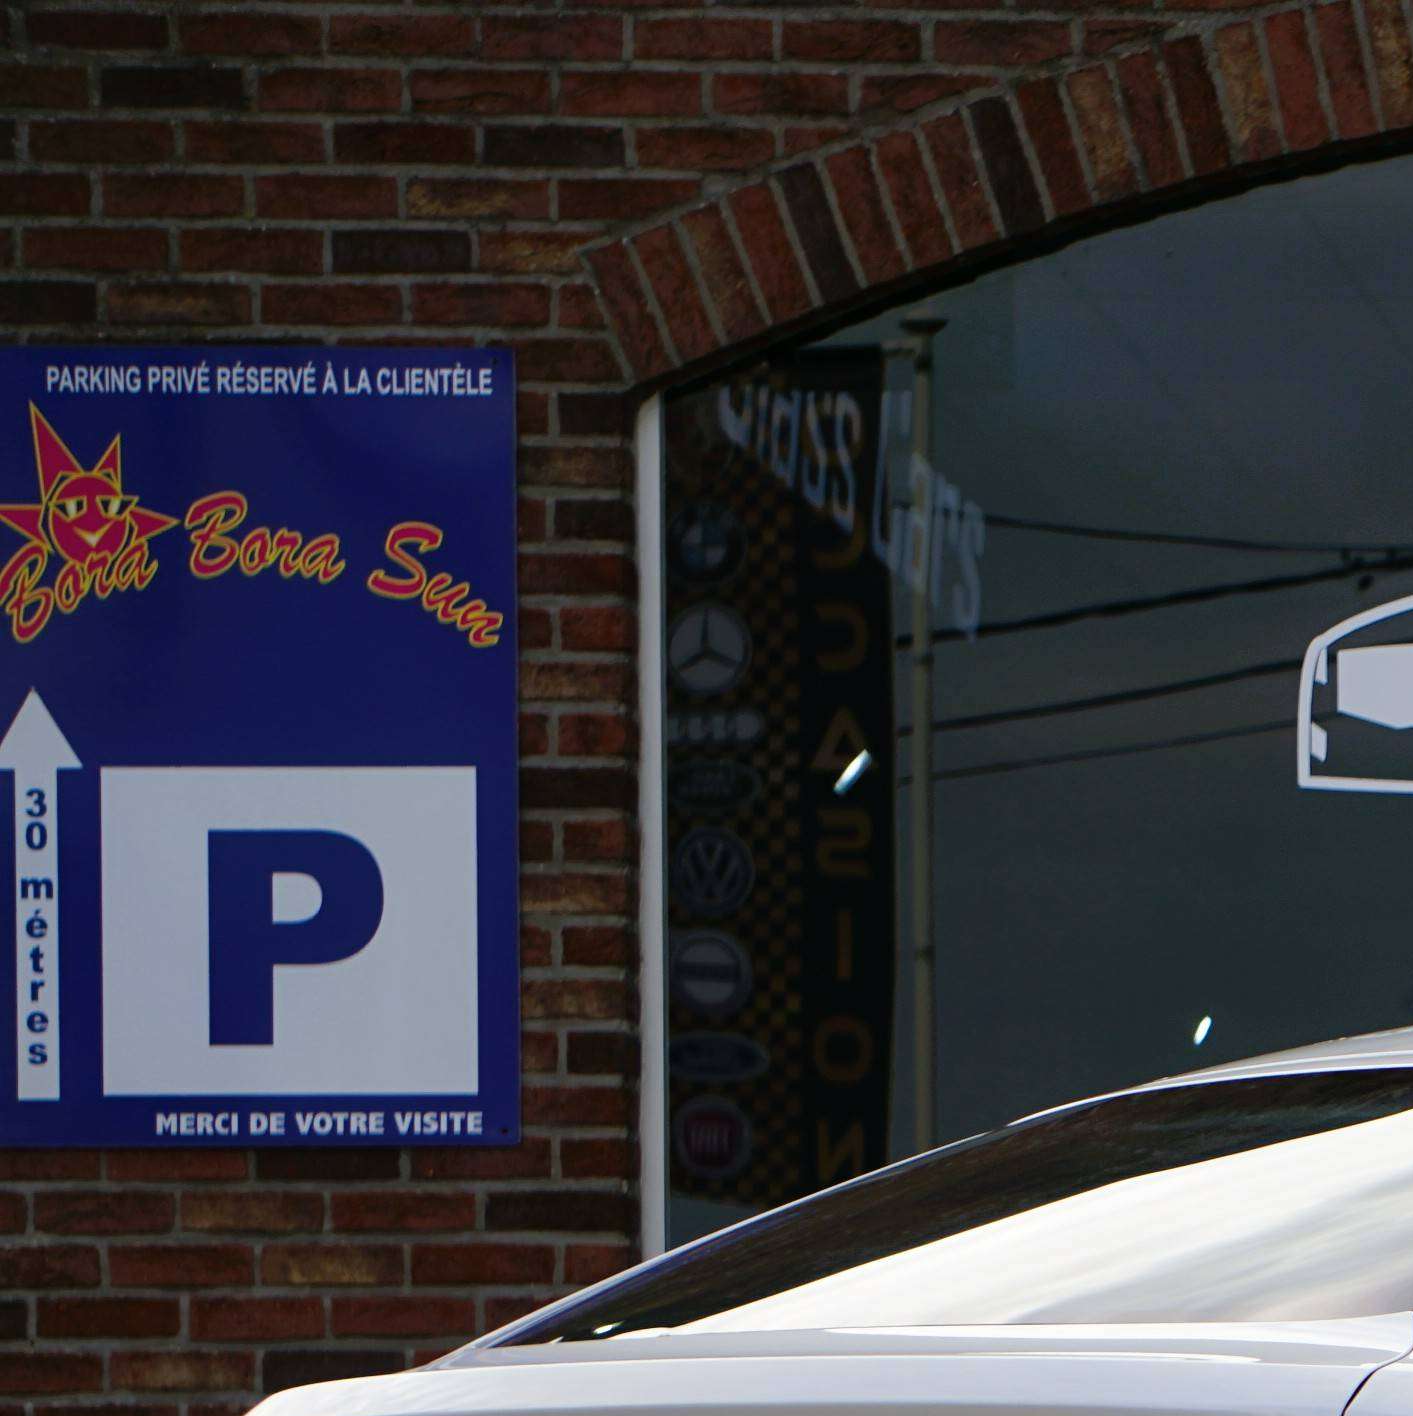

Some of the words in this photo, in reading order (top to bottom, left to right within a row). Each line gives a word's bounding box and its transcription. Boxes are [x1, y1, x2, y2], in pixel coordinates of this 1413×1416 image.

[46, 366, 142, 394] PARKING
[147, 361, 211, 394] PRIVÉ
[216, 361, 317, 394] RÉSERVÉ
[322, 361, 339, 394] À
[343, 367, 373, 395] LA
[376, 362, 493, 396] CLIENTÈLE
[0, 544, 159, 643] Bora
[184, 490, 346, 583] Bora
[366, 520, 504, 648] Sun
[25, 789, 48, 851] 30
[207, 829, 385, 1047] P
[156, 1112, 239, 1136] MERCI
[249, 1112, 285, 1136] DE
[295, 1111, 385, 1136] VOTRE
[394, 1111, 483, 1136] VISITE
